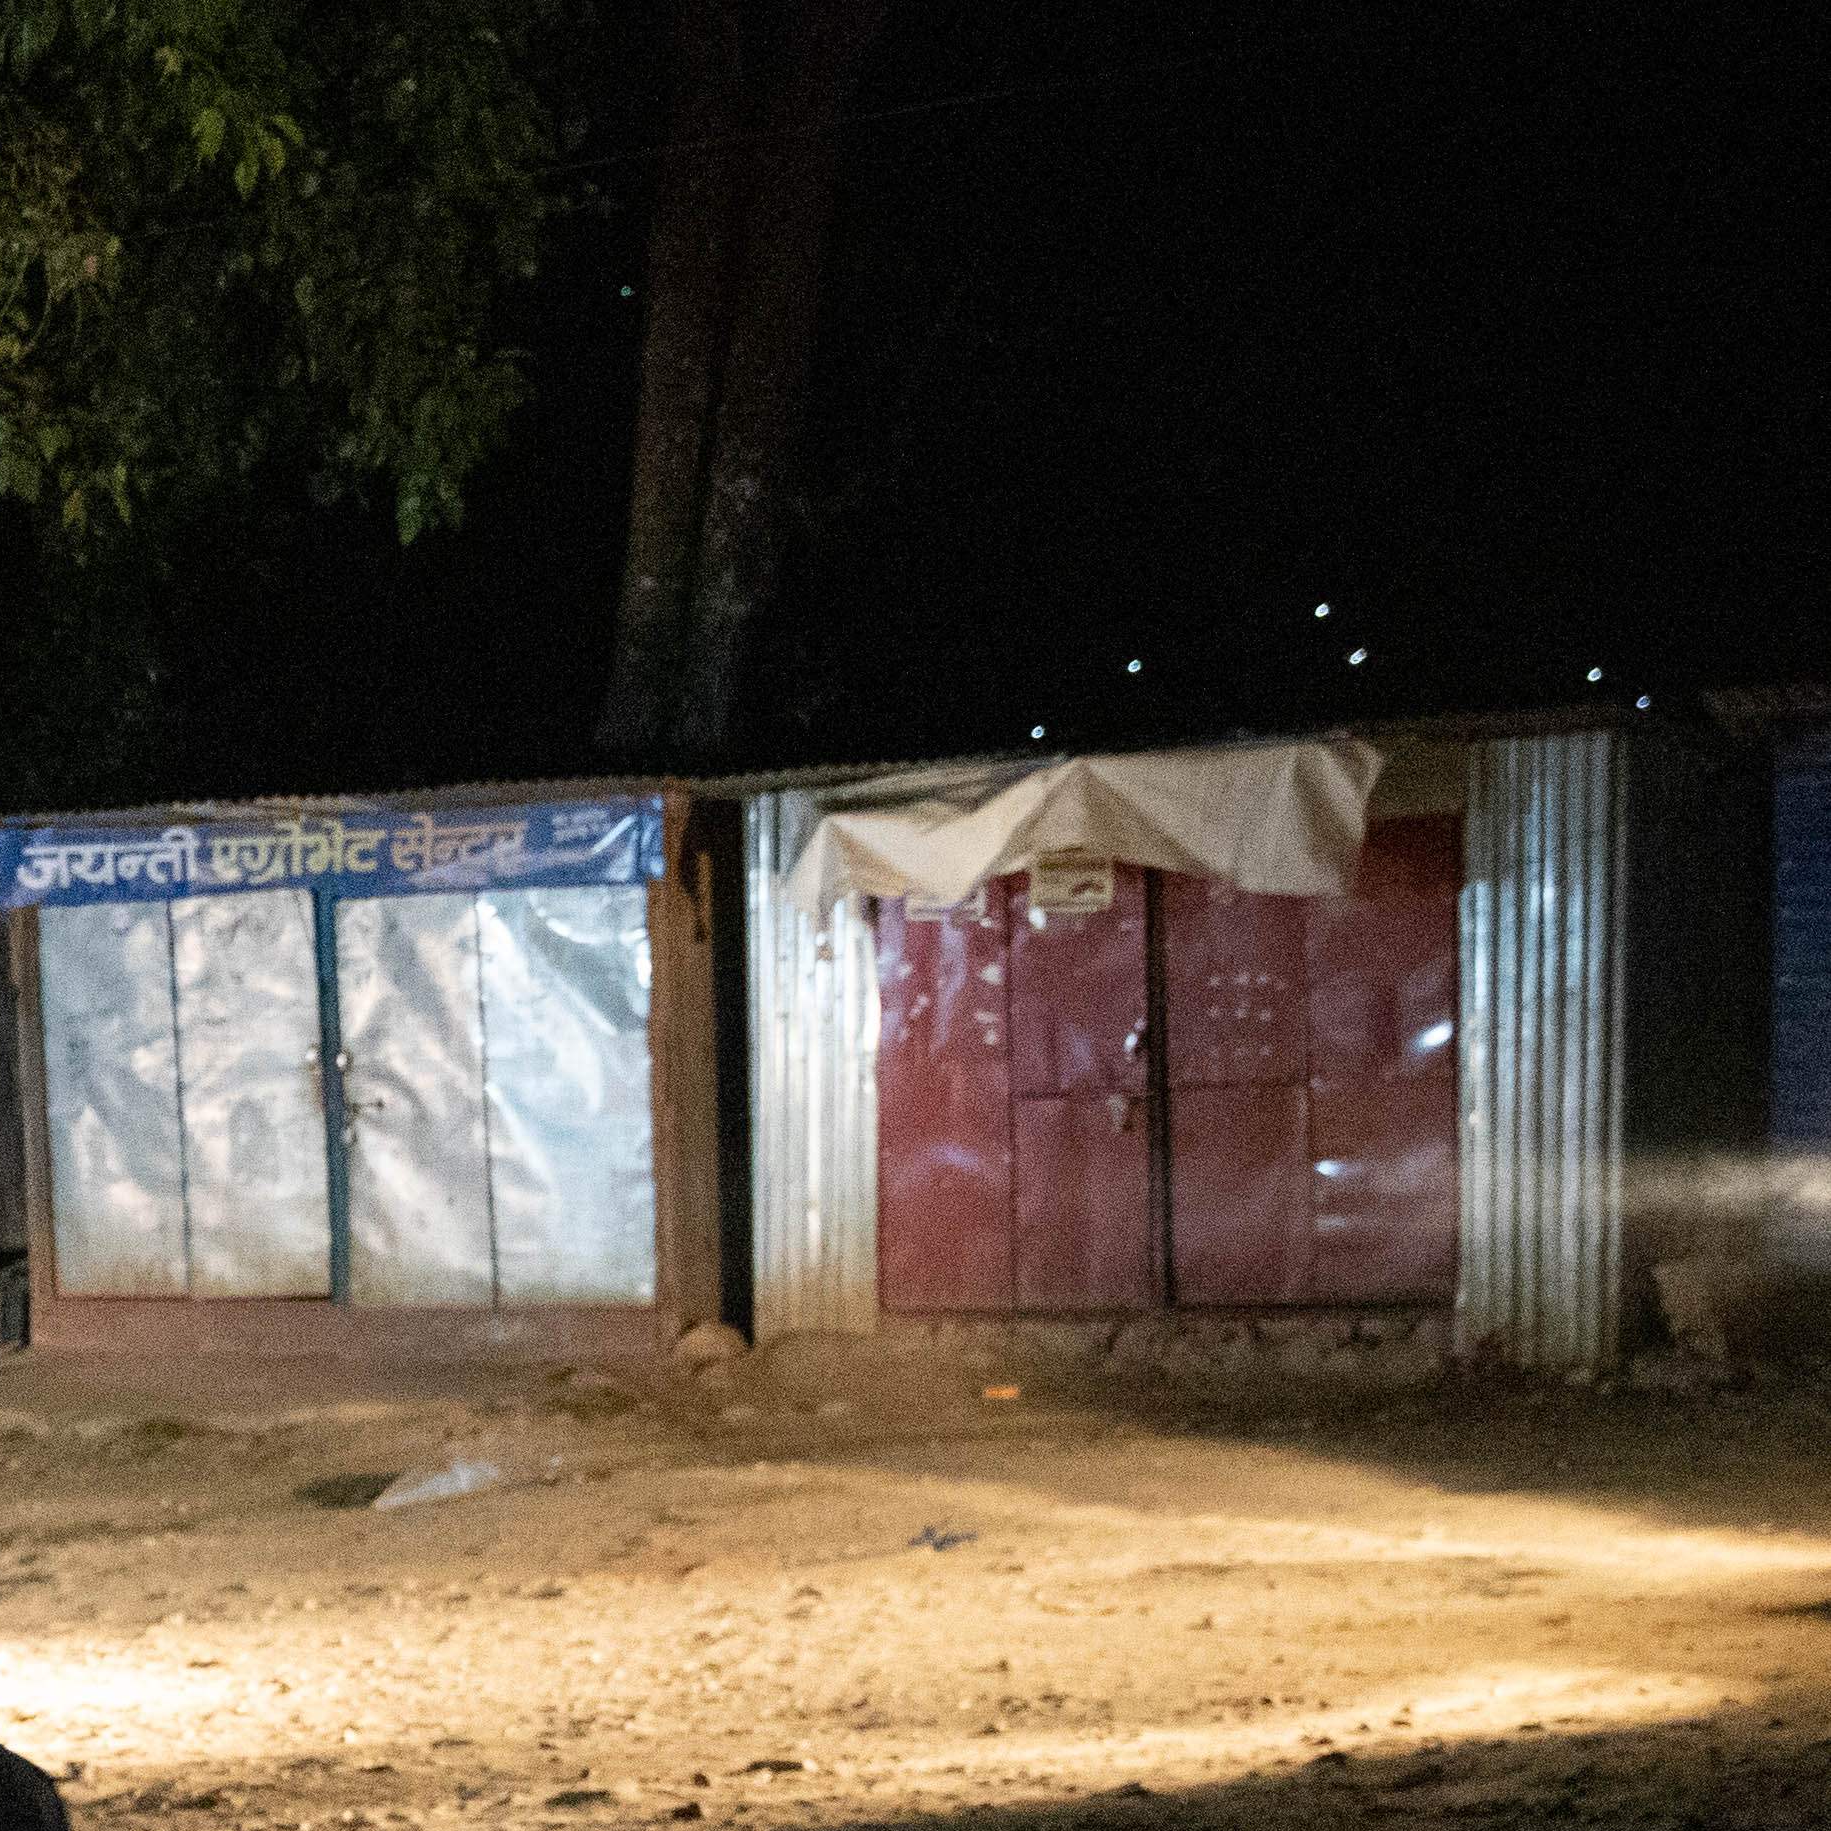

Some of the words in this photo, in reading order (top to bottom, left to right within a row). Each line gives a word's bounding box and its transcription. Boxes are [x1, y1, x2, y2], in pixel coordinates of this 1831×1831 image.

[16, 826, 202, 889] जयन्ती
[210, 819, 387, 886] एग्रोभेट
[391, 813, 528, 875] सेन्टर
